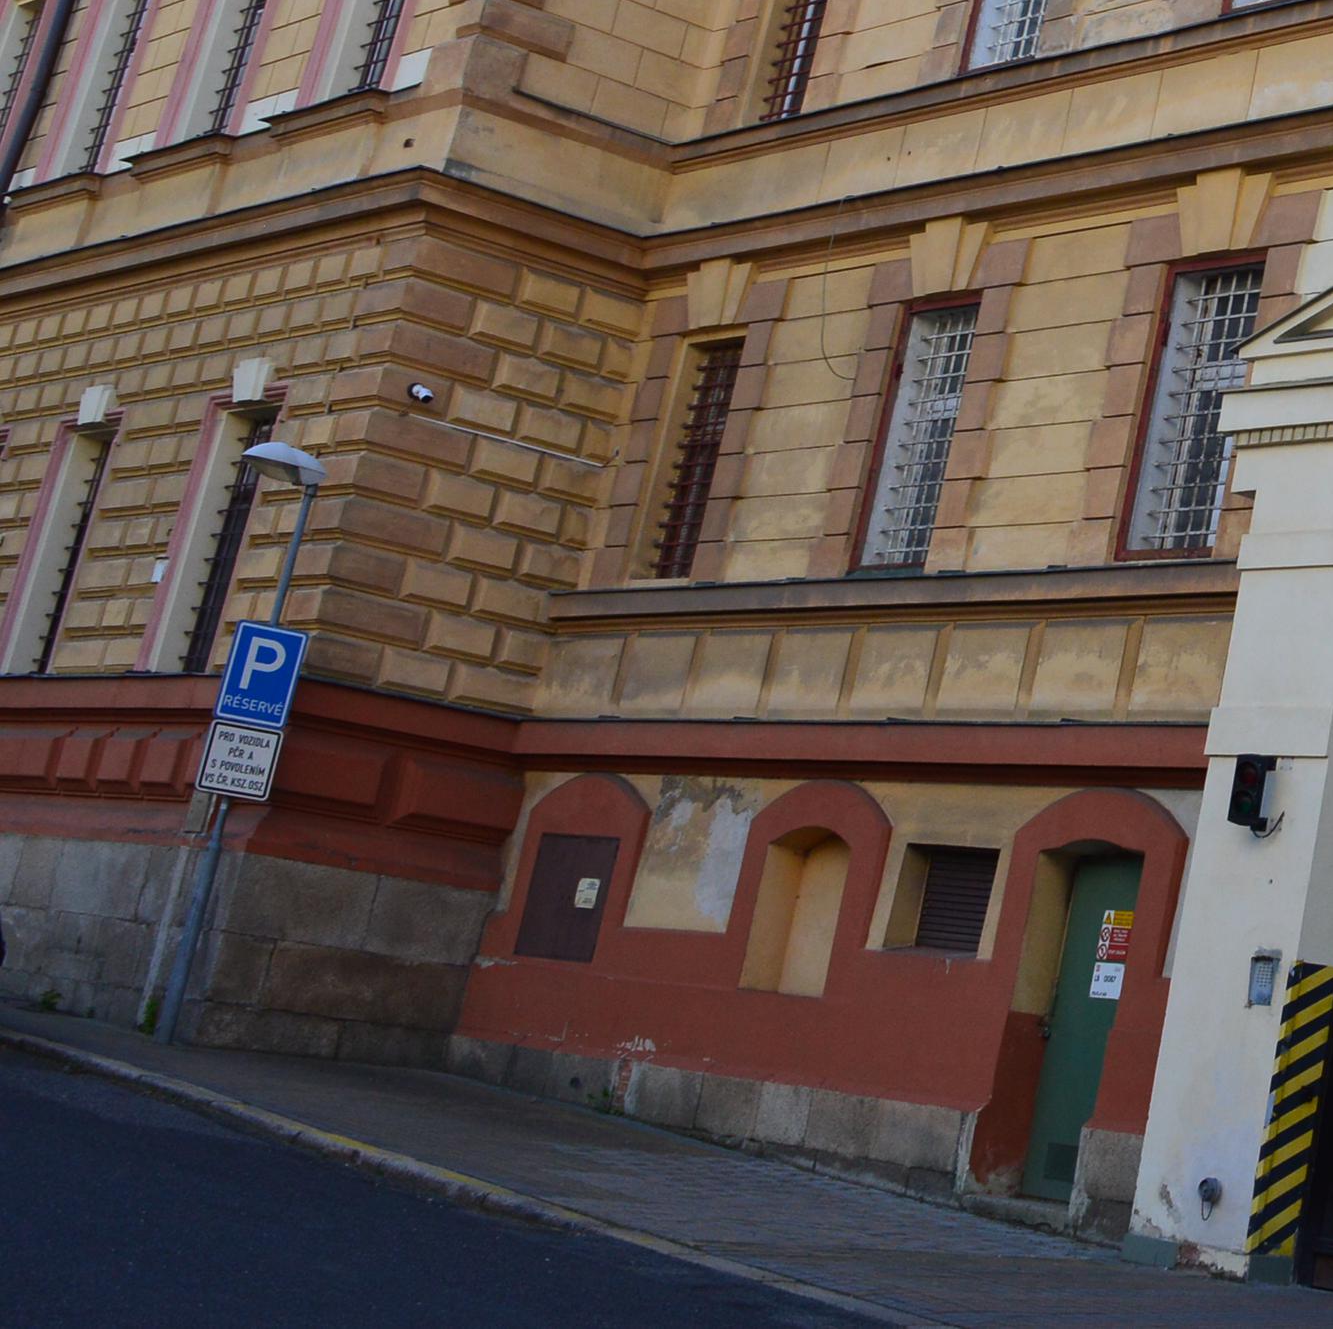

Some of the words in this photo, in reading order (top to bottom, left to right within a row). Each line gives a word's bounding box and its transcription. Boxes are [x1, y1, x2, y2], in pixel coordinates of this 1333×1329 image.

[239, 636, 286, 690] P
[223, 694, 284, 716] RÉSERVÉ
[218, 731, 235, 742] PRO
[239, 734, 271, 748] VOZIDLA
[228, 746, 245, 758] PČR
[247, 751, 254, 760] A
[211, 758, 217, 768] S
[219, 760, 266, 777] POVOLENÍM
[204, 772, 215, 783] VS
